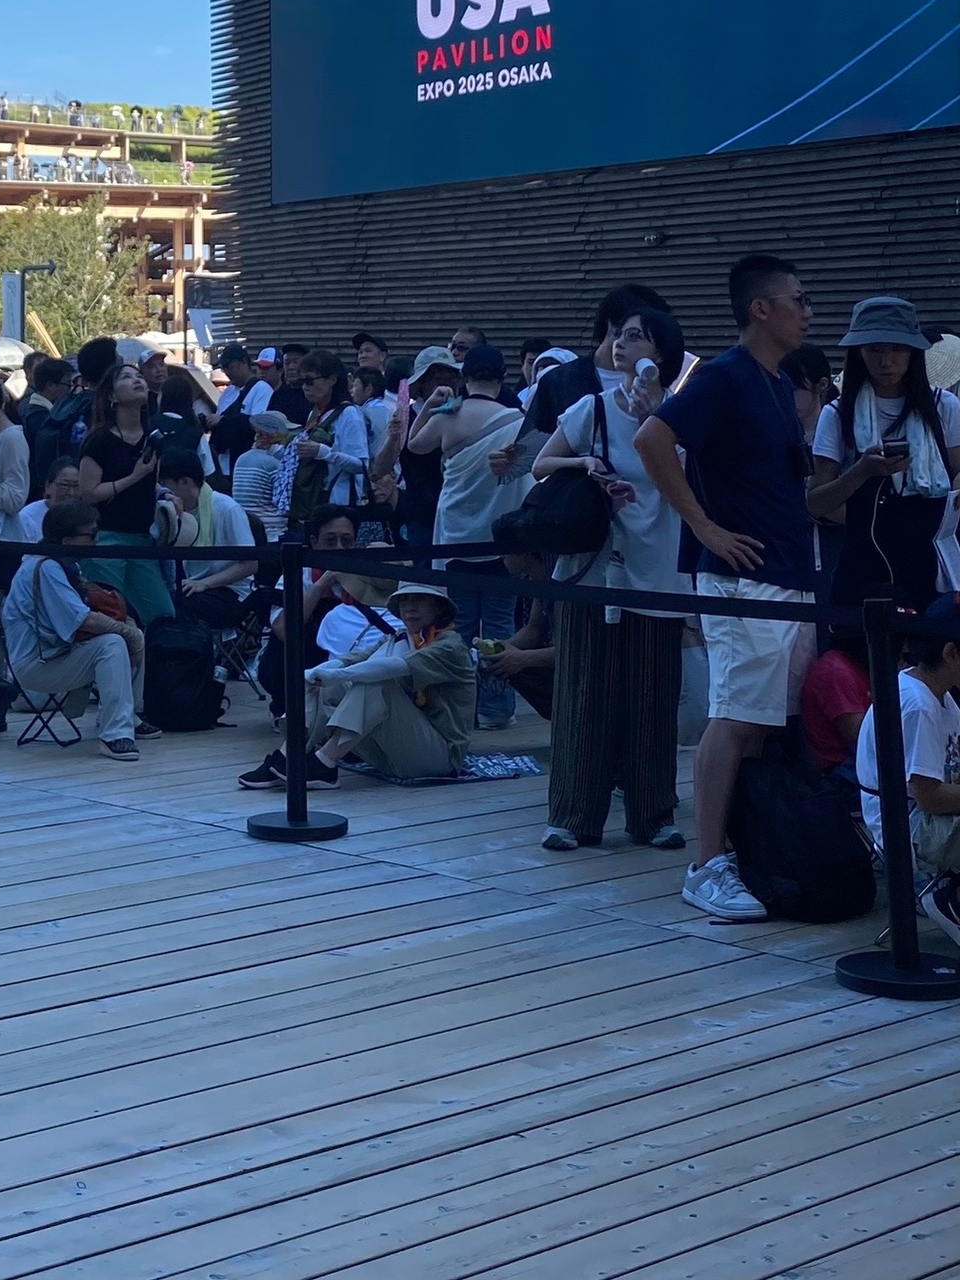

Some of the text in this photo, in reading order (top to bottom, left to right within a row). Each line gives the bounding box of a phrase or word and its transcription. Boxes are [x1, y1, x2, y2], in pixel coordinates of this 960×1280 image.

[417, 24, 552, 74] PAVILION
[417, 61, 552, 102] EXPO 2025 OSAKA
